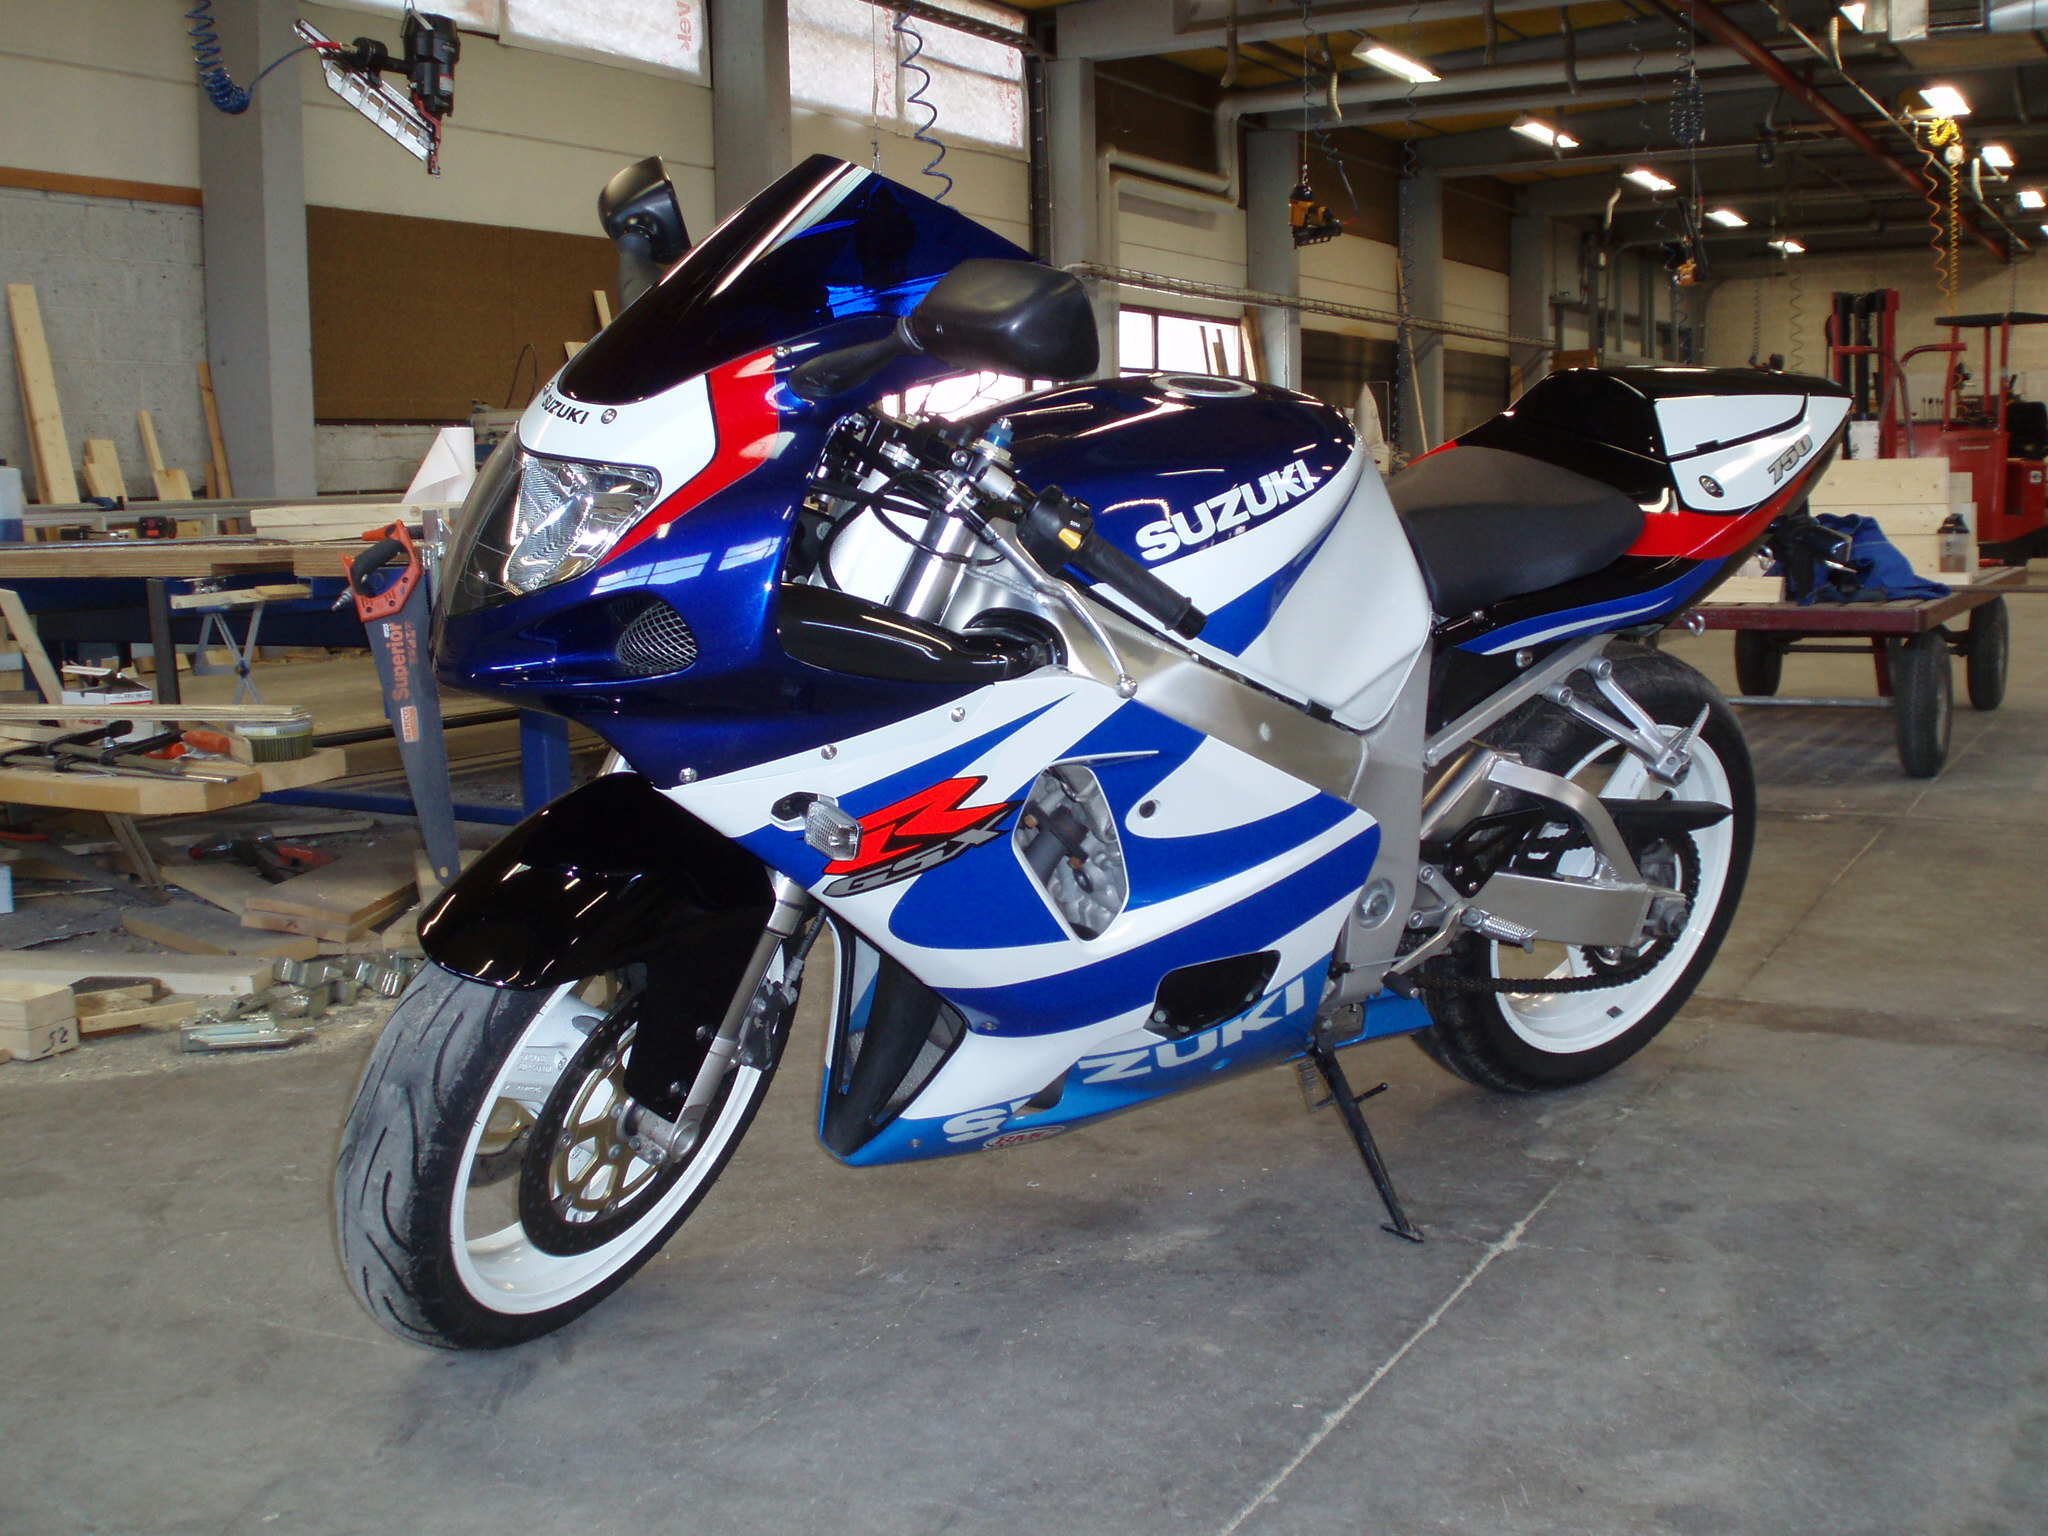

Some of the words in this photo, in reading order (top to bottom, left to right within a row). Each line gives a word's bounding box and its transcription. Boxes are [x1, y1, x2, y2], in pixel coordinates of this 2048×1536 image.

[541, 394, 590, 425] SUZUKI
[1767, 434, 1814, 485] 750
[1135, 459, 1316, 561] SUZUKI
[386, 622, 410, 701] Superior
[942, 976, 1305, 1143] SZUKI
